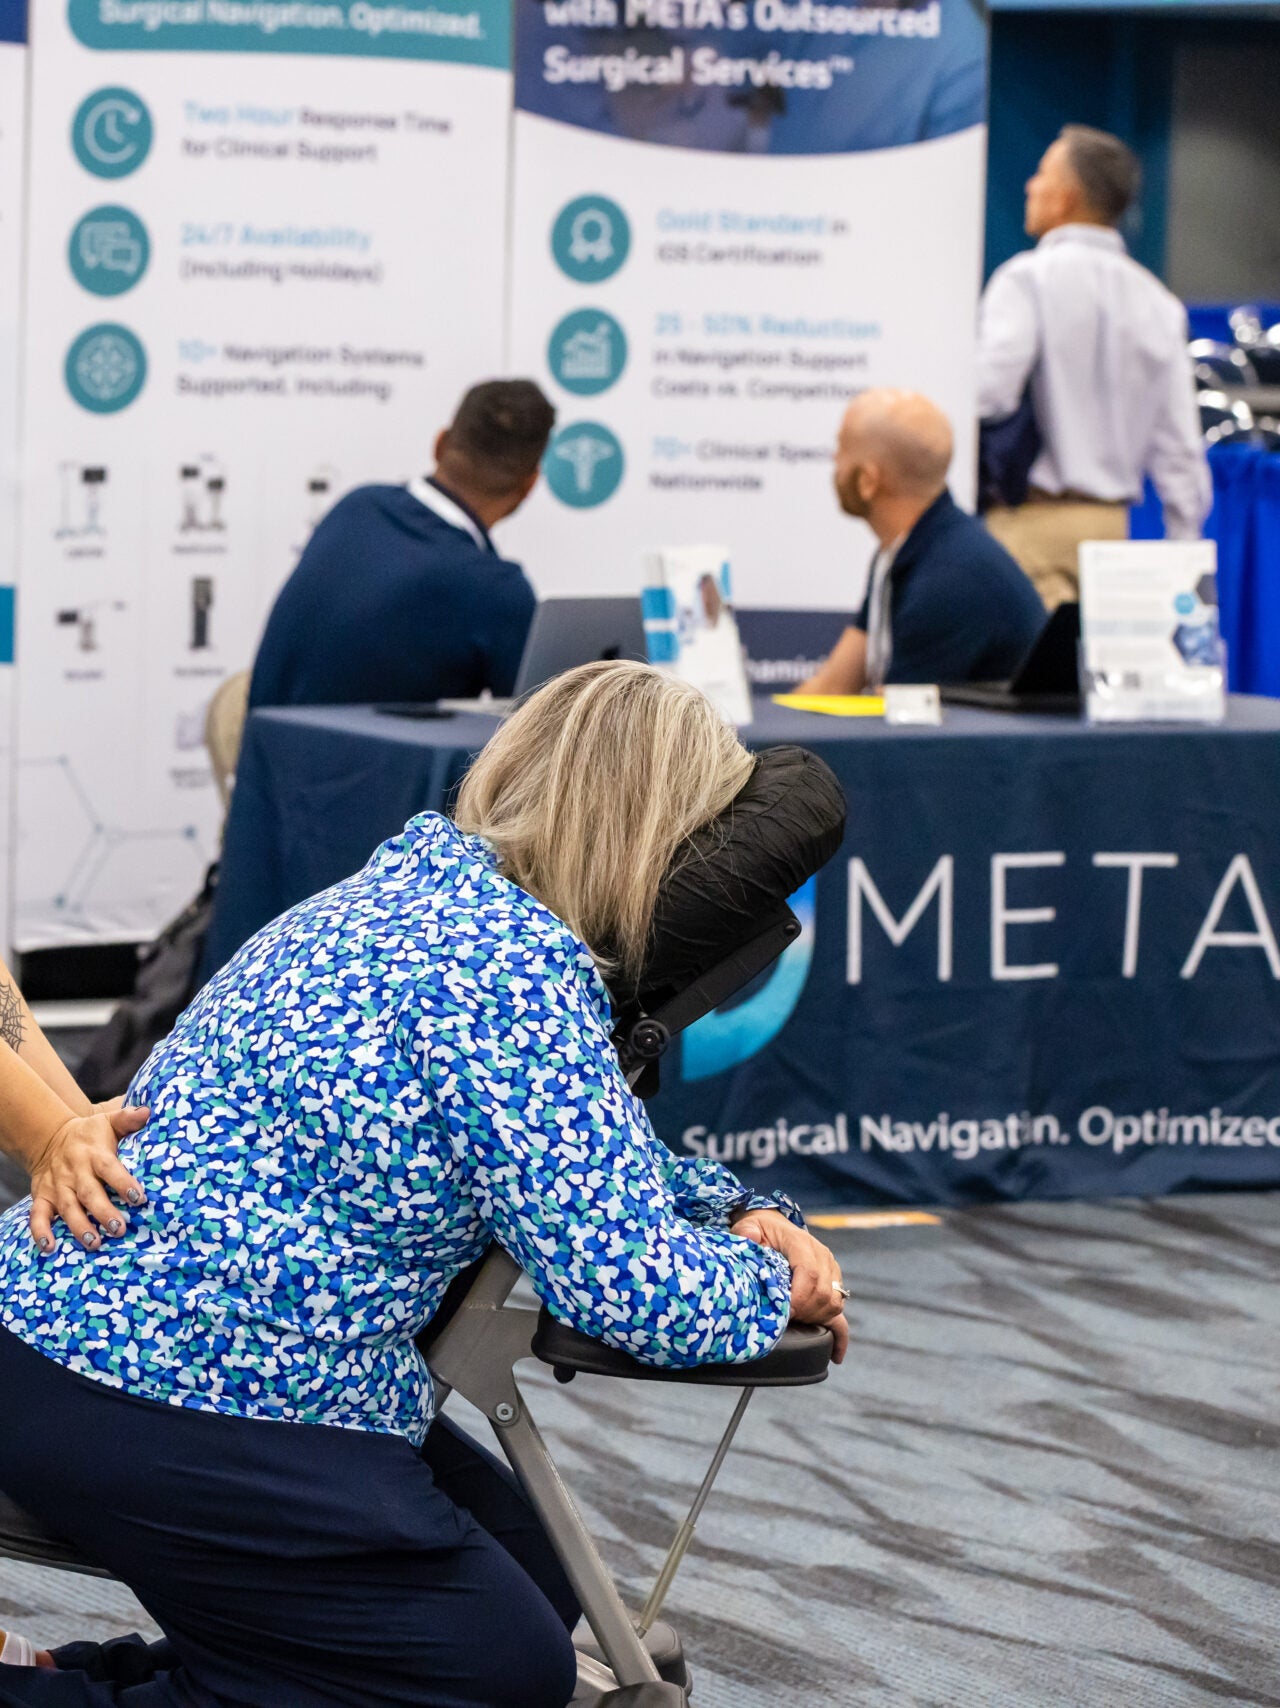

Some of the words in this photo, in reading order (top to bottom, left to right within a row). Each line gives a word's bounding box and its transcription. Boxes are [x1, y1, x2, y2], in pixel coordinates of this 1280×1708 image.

[99, 0, 204, 31] Surgical
[208, 1, 345, 33] Navigation.
[349, 3, 485, 39] Optimized.
[544, 0, 617, 27] with
[623, 0, 746, 29] META's
[754, 0, 941, 38] Outsourced
[543, 46, 683, 91] Surgical
[300, 105, 397, 132] Response
[404, 111, 450, 135] Time
[182, 138, 207, 158] for
[214, 138, 288, 158] Clinical
[297, 141, 377, 163] Support
[721, 211, 824, 235] Standard
[181, 223, 233, 246] 24/7
[239, 225, 372, 252] Availability
[694, 244, 822, 266] Certification
[761, 317, 880, 339] Reduction
[223, 345, 332, 368] Navigation
[339, 345, 424, 367] Systems
[677, 349, 781, 369] Navigation
[789, 350, 868, 371] Support
[652, 378, 710, 397] Costs
[696, 440, 768, 462] Clinical
[650, 472, 763, 489] Nationwide
[846, 851, 1280, 985] META
[681, 1113, 849, 1168] Surgical
